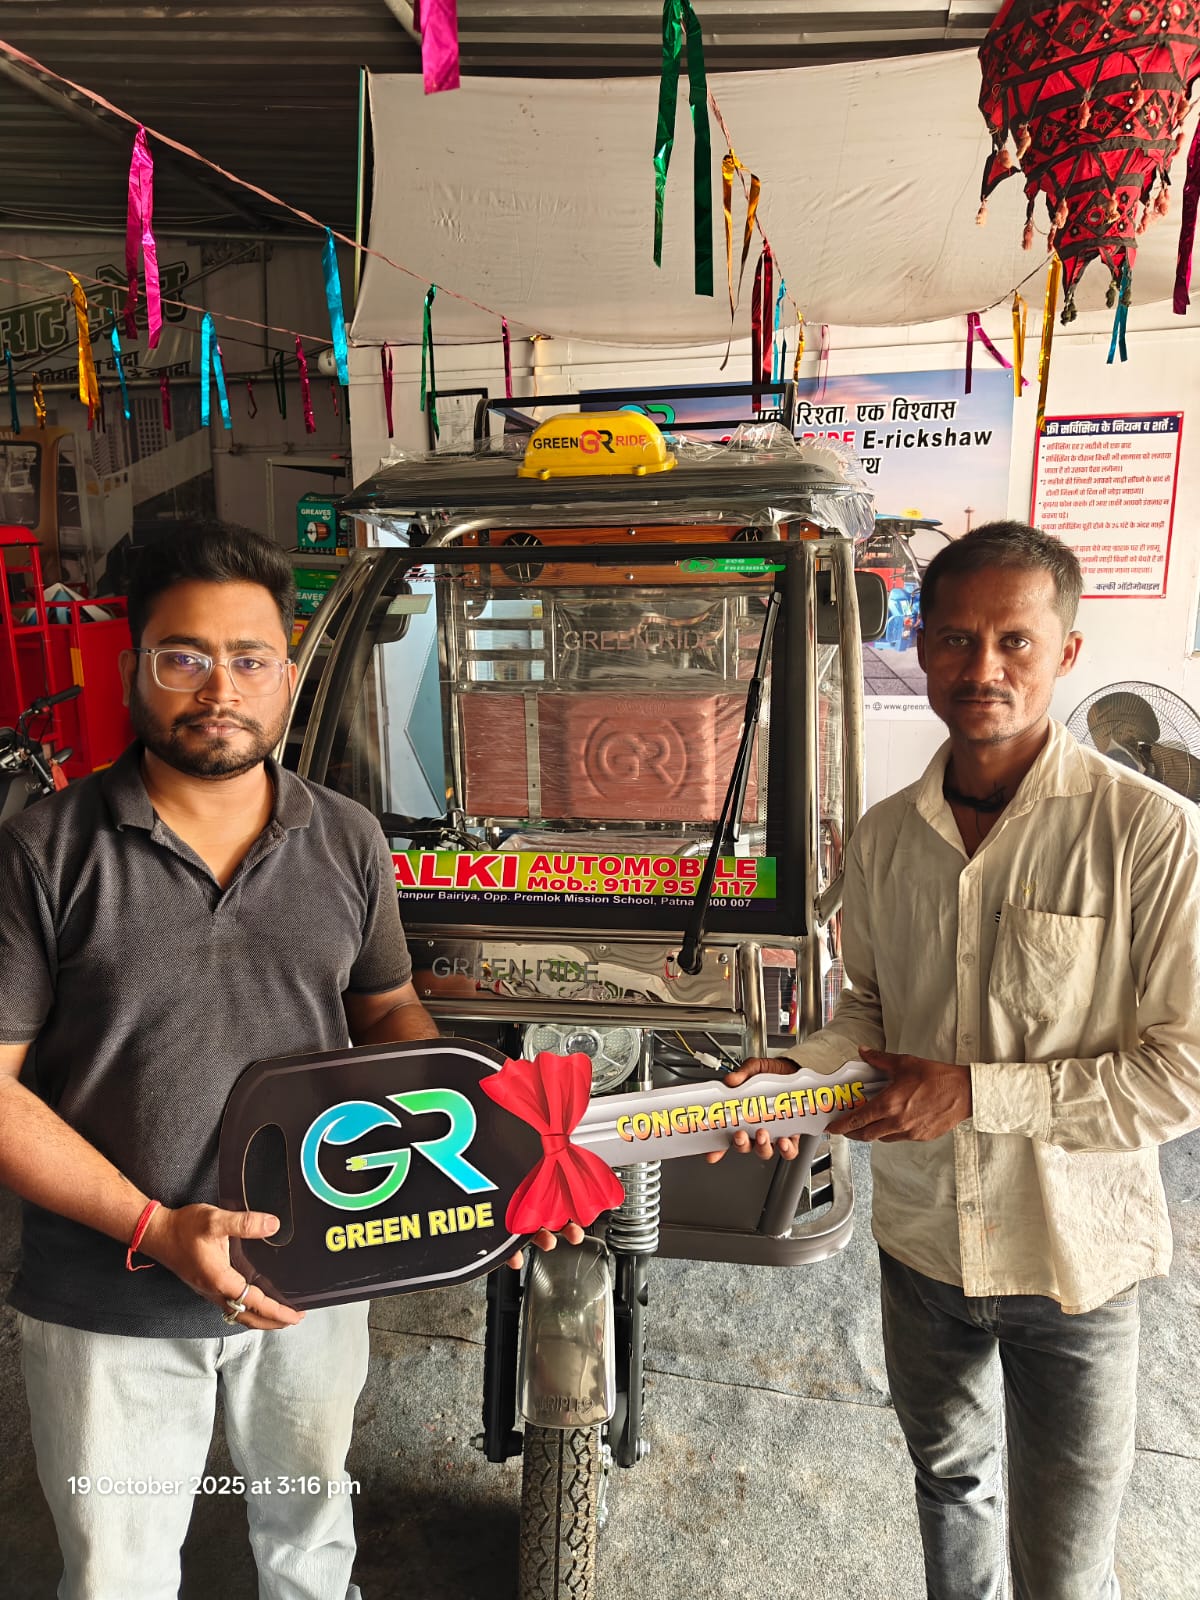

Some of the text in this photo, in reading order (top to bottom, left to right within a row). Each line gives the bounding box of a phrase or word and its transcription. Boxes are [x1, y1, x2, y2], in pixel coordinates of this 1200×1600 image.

[856, 404, 886, 422] एक
[892, 398, 957, 421] विश्वास
[1101, 420, 1111, 432] के
[1112, 420, 1142, 432] नियम
[533, 430, 647, 454] GREEN GR RIDE
[863, 427, 993, 449] E-rickshaw
[301, 508, 331, 516] GREAVES
[563, 630, 717, 651] GREEN RIDE
[527, 876, 597, 893] Mob.:
[603, 878, 658, 894] 9117
[438, 891, 480, 902] Bairiya,
[484, 892, 511, 902] Opp.
[514, 893, 561, 902] Premlok
[564, 894, 609, 904] Mission
[613, 895, 657, 906] School,
[661, 896, 695, 906] Patna
[730, 898, 751, 908] 007
[431, 956, 600, 984] GREEN RIDE
[616, 1081, 868, 1142] CONGRATULATIONS
[300, 1088, 499, 1210] GR
[325, 1202, 495, 1252] GREEN RIDE
